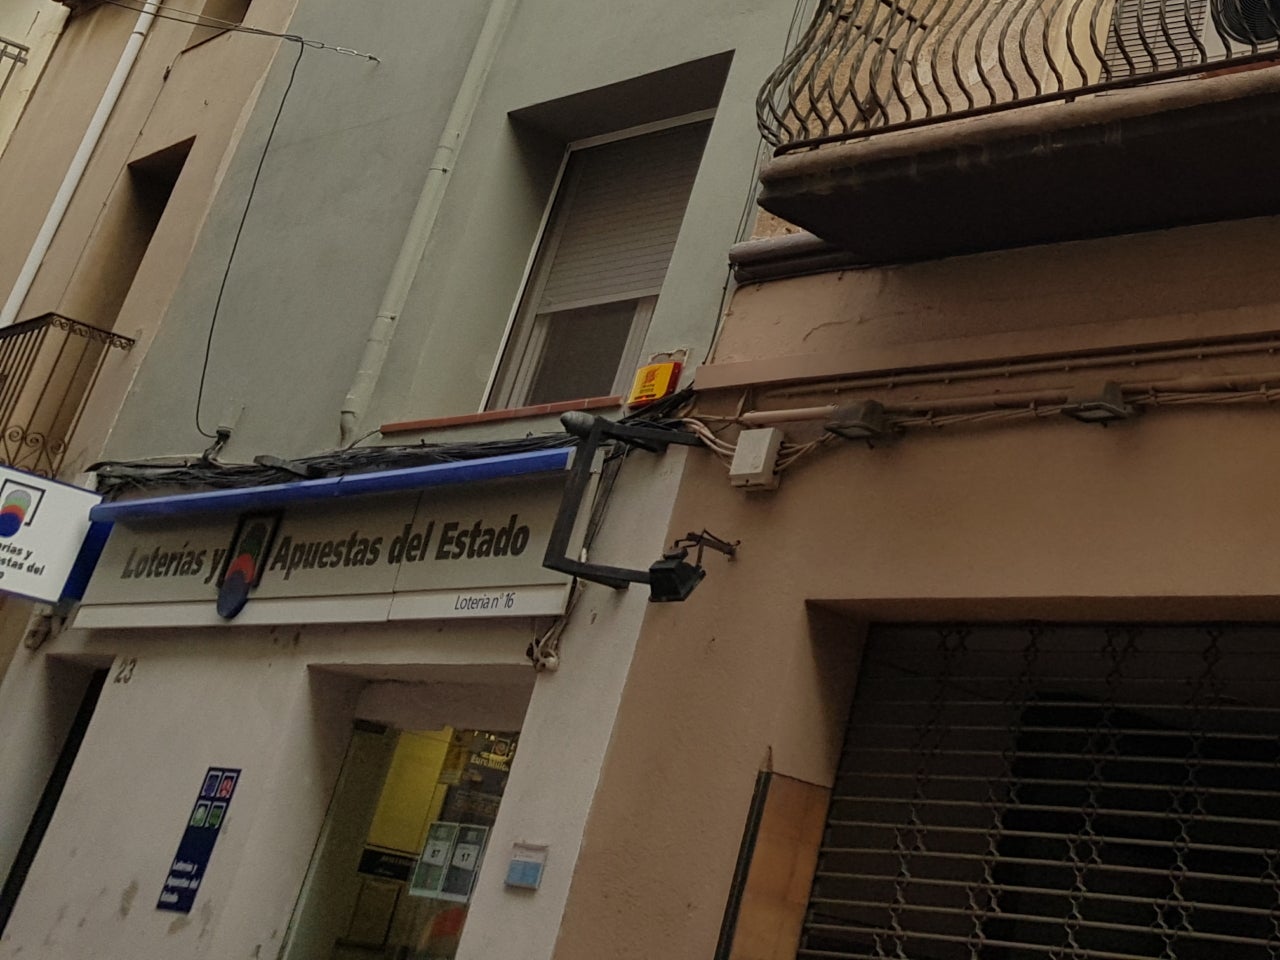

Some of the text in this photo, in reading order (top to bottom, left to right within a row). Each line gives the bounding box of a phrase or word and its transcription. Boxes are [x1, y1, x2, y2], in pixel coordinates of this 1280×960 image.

[23, 549, 34, 561] y
[121, 513, 530, 585] Loterías y Apuestas del Estado
[26, 562, 46, 576] del
[503, 592, 516, 609] 16
[113, 656, 137, 684] 23
